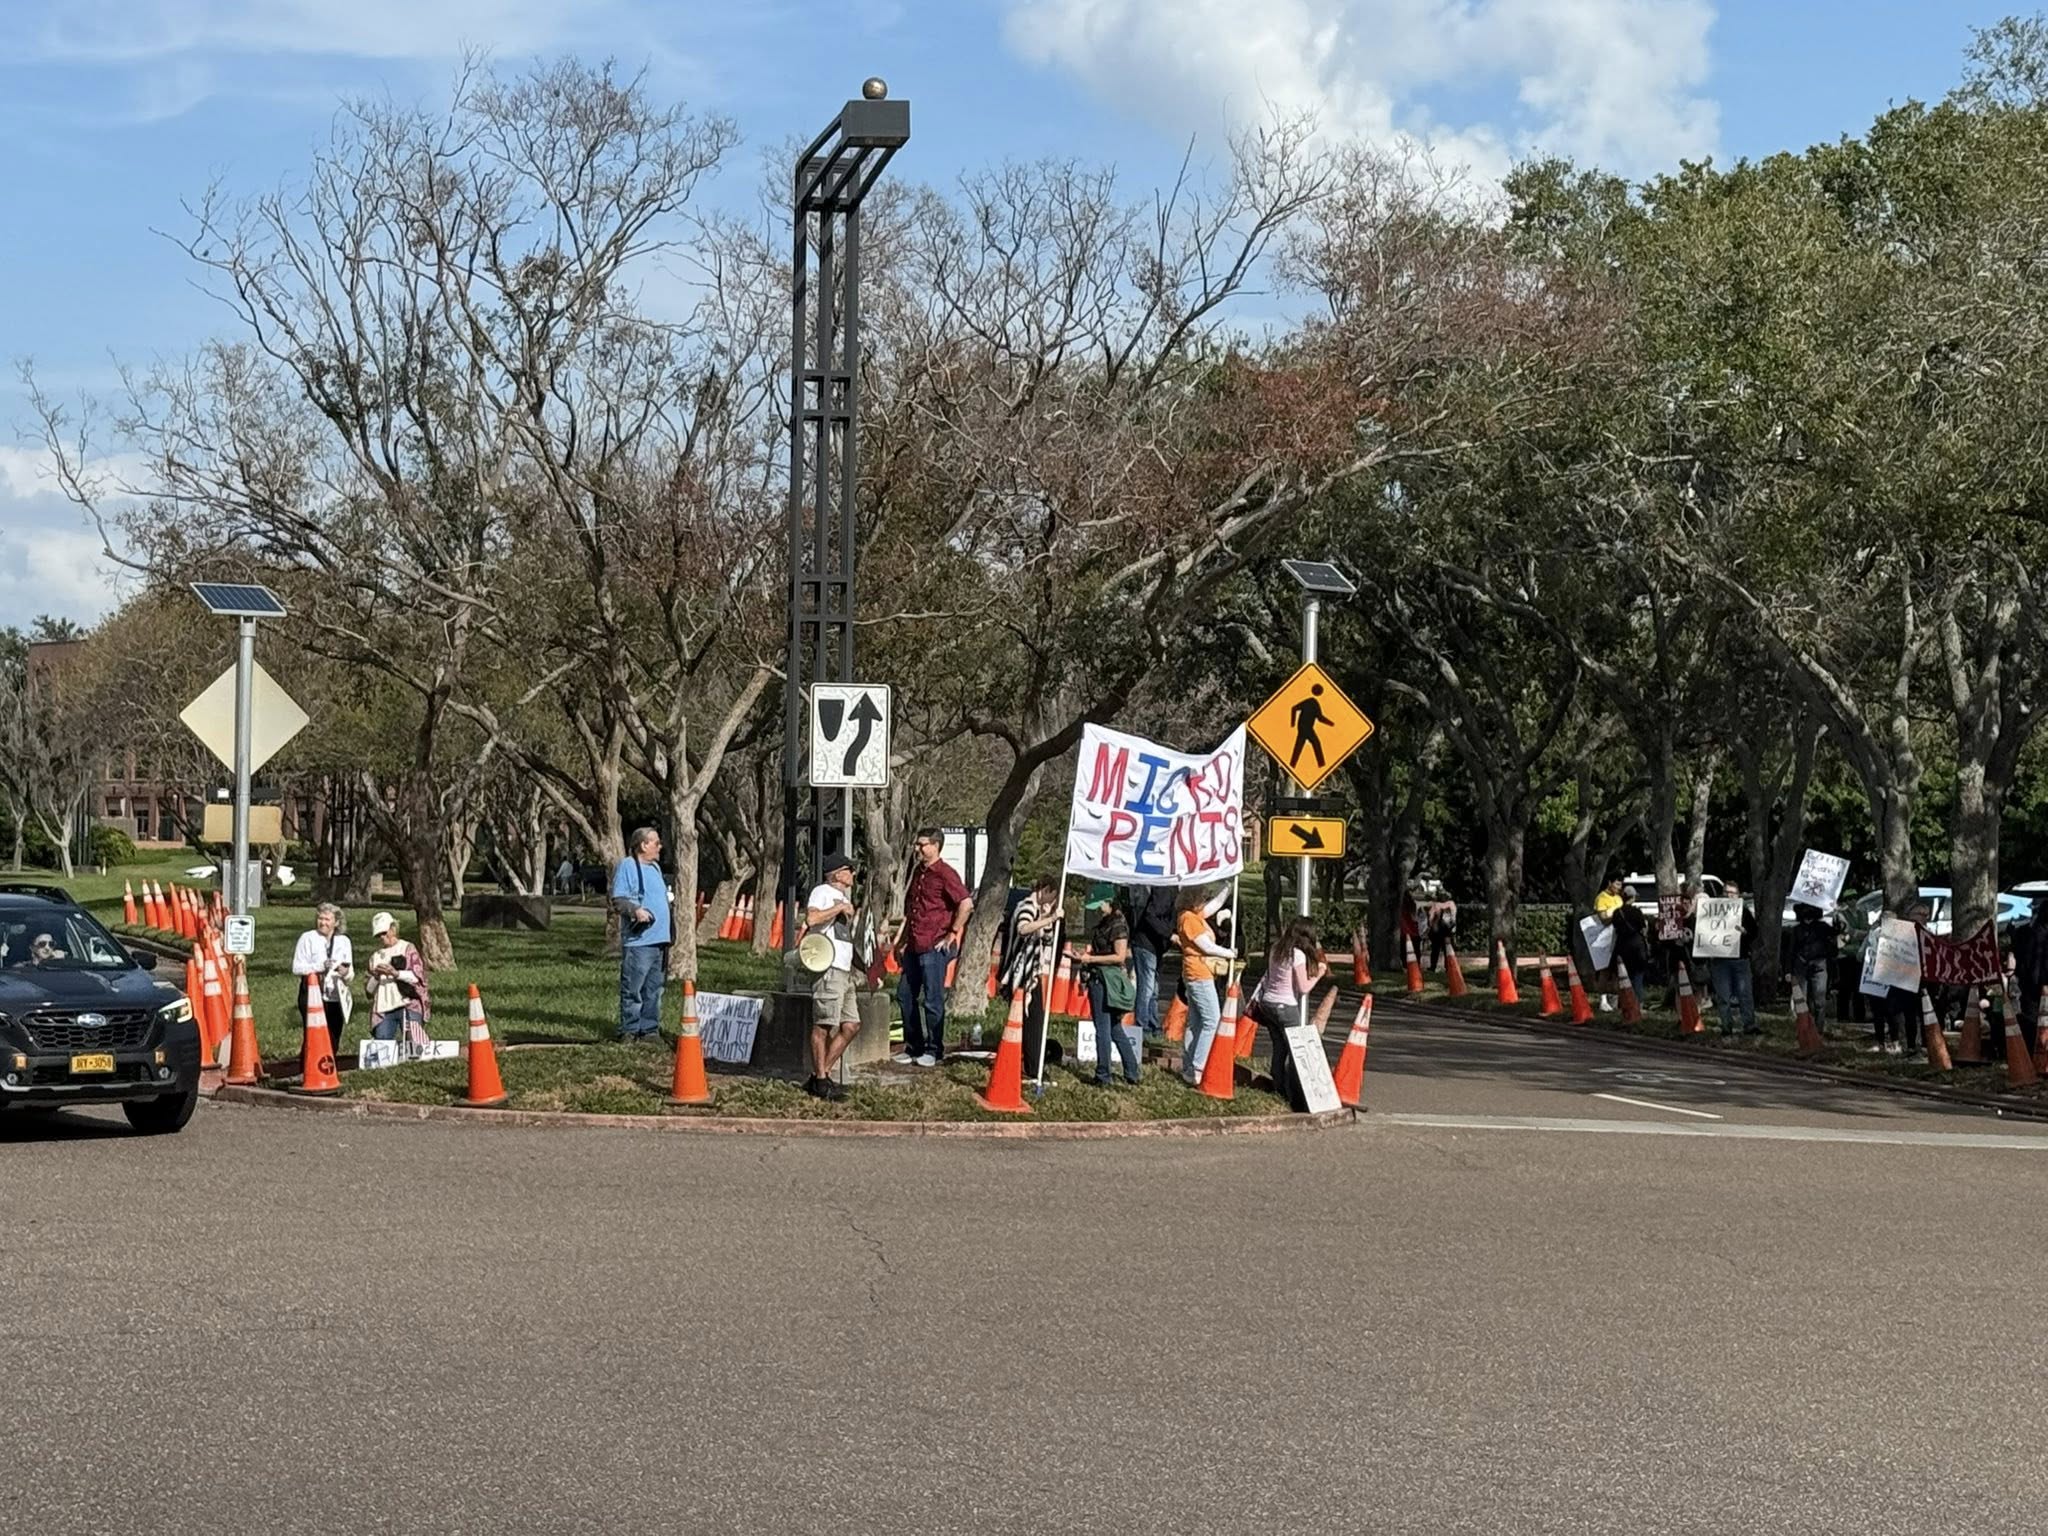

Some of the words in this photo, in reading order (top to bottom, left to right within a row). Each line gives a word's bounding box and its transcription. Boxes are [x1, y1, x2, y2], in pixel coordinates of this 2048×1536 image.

[1086, 741, 1232, 814] MICRO
[1101, 805, 1239, 876] PENIS
[1696, 934, 1732, 949] ICE
[717, 1019, 732, 1041] ON
[736, 1020, 754, 1043] ICE
